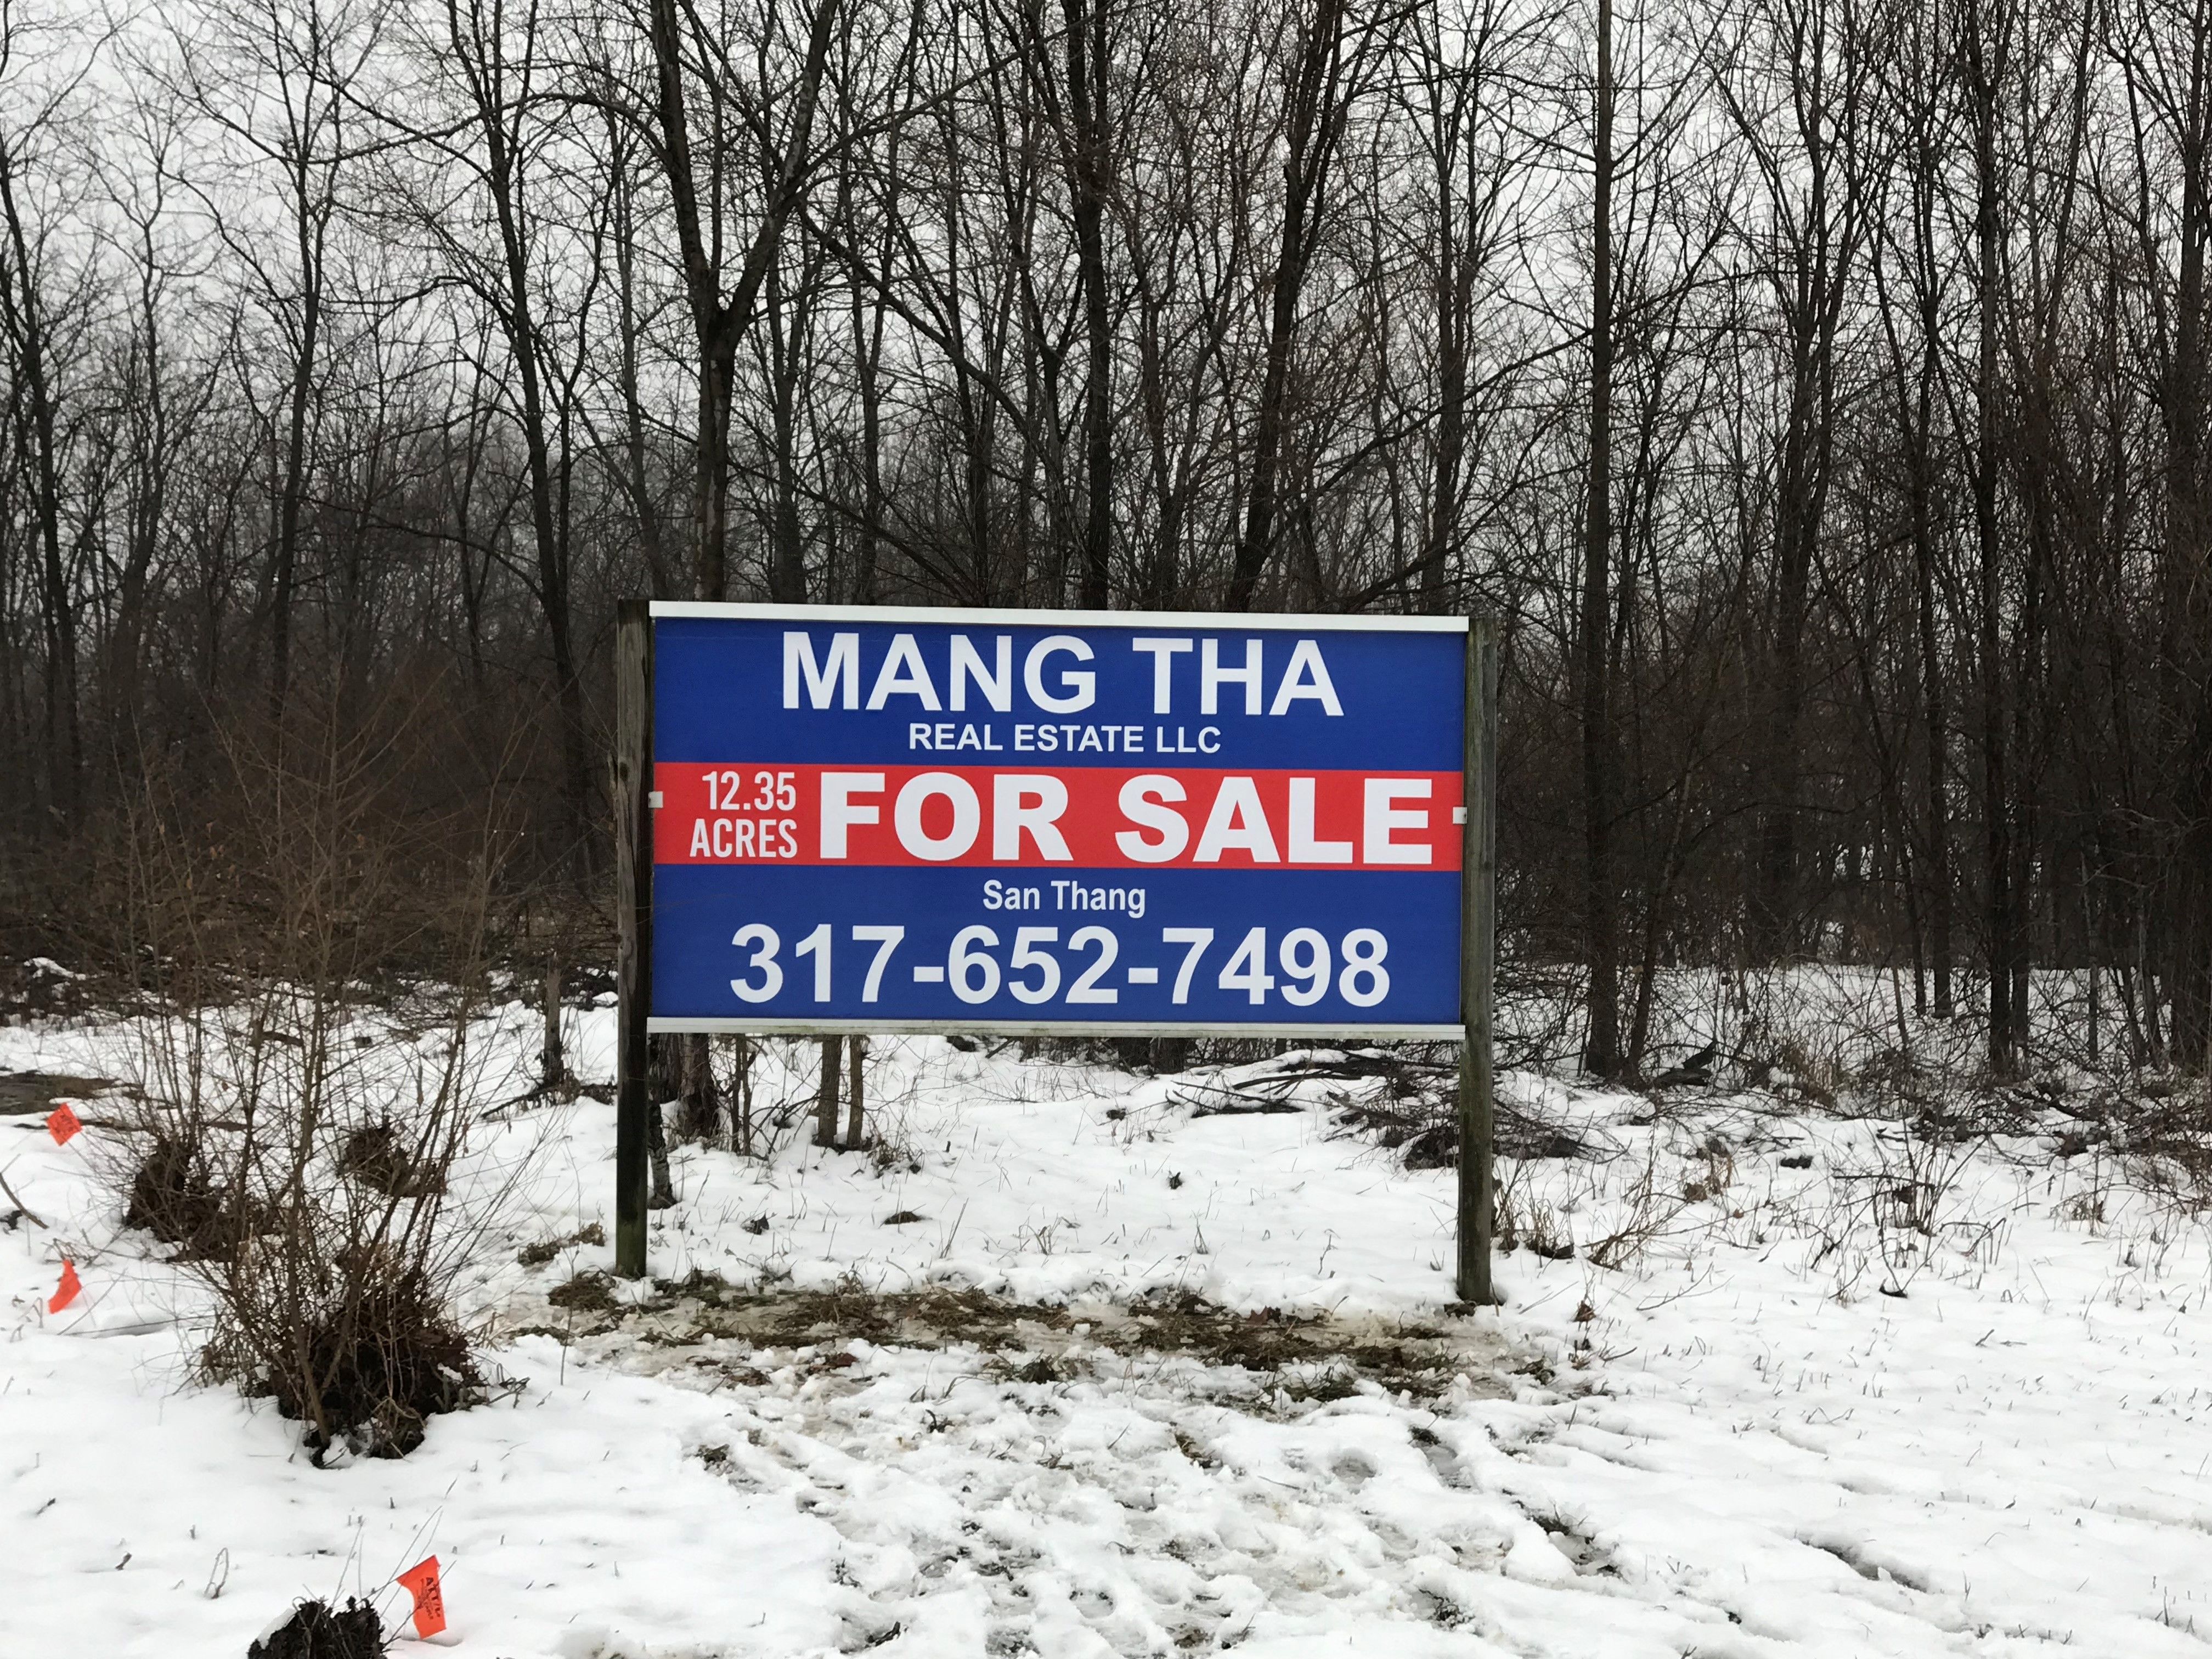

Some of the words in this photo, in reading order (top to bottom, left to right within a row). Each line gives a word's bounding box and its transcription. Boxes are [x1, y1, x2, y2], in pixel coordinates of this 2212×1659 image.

[783, 631, 1096, 714] MANG
[1132, 637, 1344, 716] THA
[910, 723, 1003, 751] REAL
[1014, 724, 1144, 752] ESTATE
[1156, 726, 1221, 753] LLC
[702, 771, 796, 811] 12.35
[689, 818, 798, 859] ACRES
[820, 771, 1074, 861] FOR
[1115, 774, 1432, 865] SALE
[983, 879, 1040, 910] San
[1051, 881, 1146, 918] Thang
[730, 923, 1390, 1007] 317-652-7498
